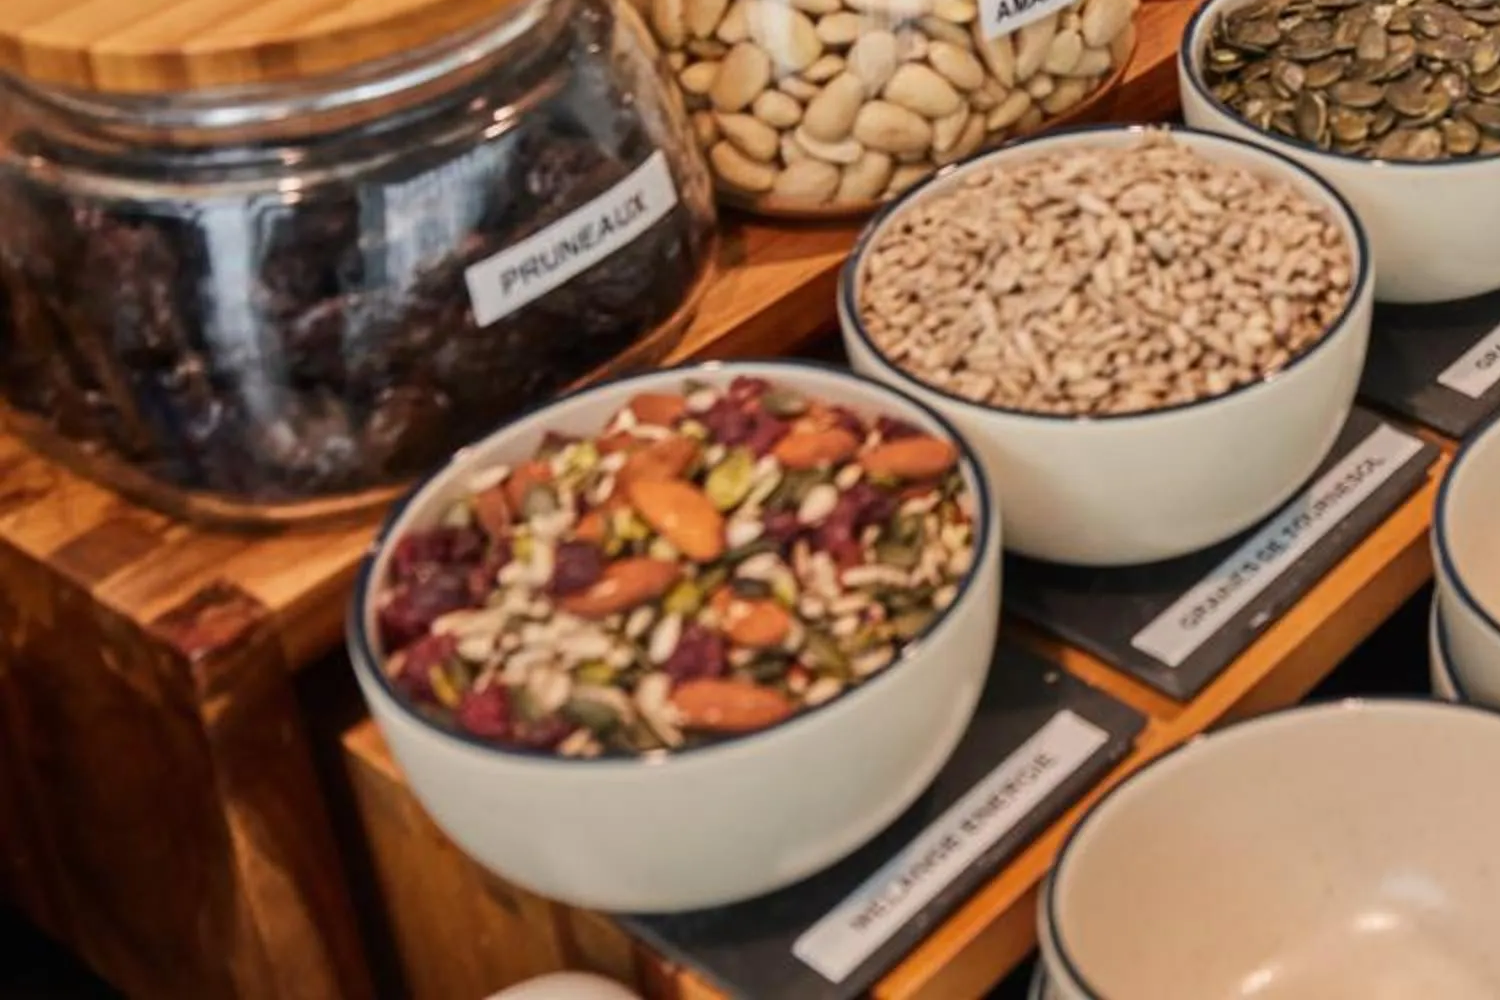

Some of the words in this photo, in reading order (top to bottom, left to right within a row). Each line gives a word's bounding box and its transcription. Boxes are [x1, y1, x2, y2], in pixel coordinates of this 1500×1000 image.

[499, 190, 648, 294] PRUNEAUX
[1179, 561, 1260, 631] GRAINES
[1255, 540, 1282, 564] DE
[1282, 455, 1387, 542] TOURNESOL
